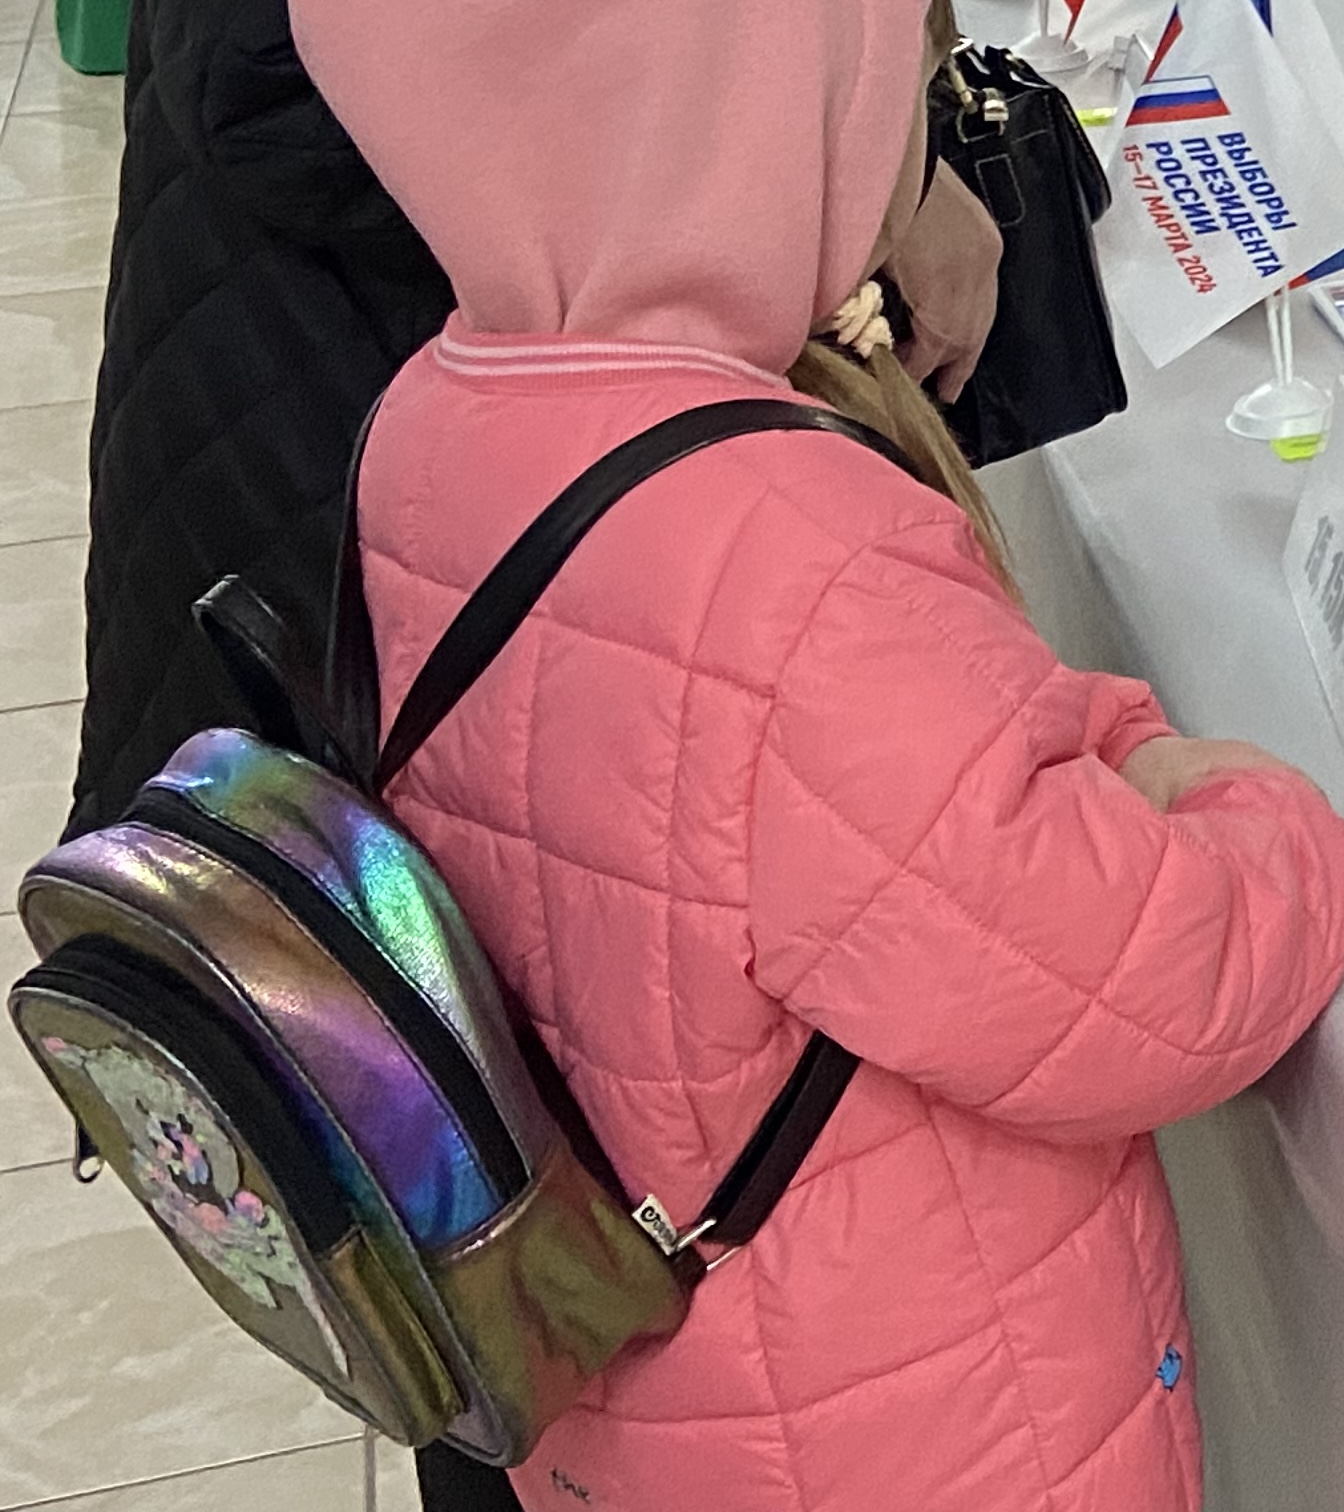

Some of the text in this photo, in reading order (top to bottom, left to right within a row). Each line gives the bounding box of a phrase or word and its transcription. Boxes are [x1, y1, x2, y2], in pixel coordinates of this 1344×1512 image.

[1145, 141, 1222, 235] РОССИИ
[1180, 137, 1285, 278] ПРЕЗИДЕНТА
[1217, 132, 1298, 231] ВЫБОРЫ
[1141, 195, 1193, 254] МАРТА
[1176, 255, 1217, 294] 2024
